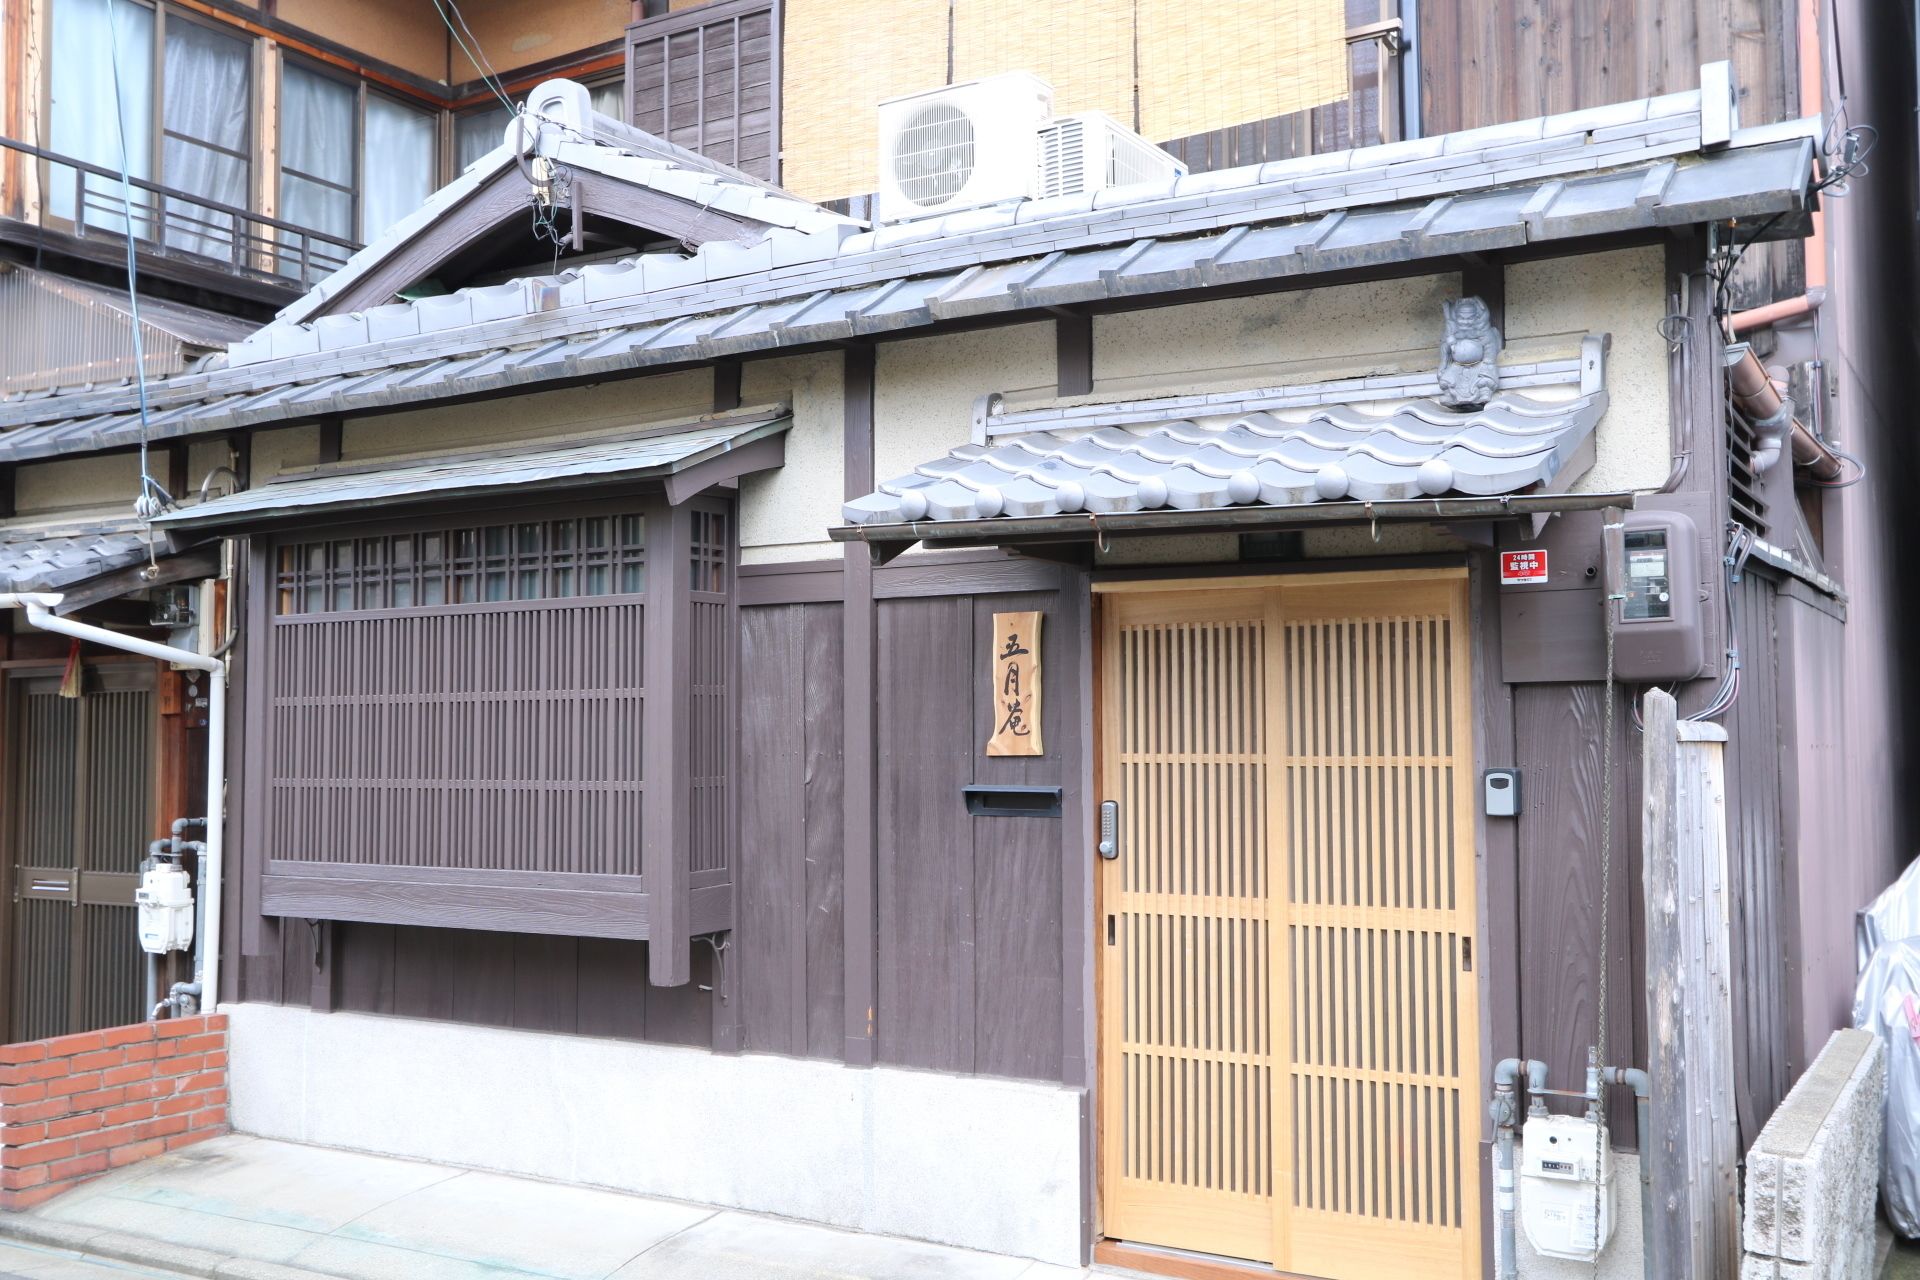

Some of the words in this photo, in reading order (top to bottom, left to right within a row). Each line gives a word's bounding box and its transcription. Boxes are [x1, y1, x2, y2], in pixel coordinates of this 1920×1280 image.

[1512, 553, 1535, 561] 24時間
[1509, 560, 1539, 570] 監視中
